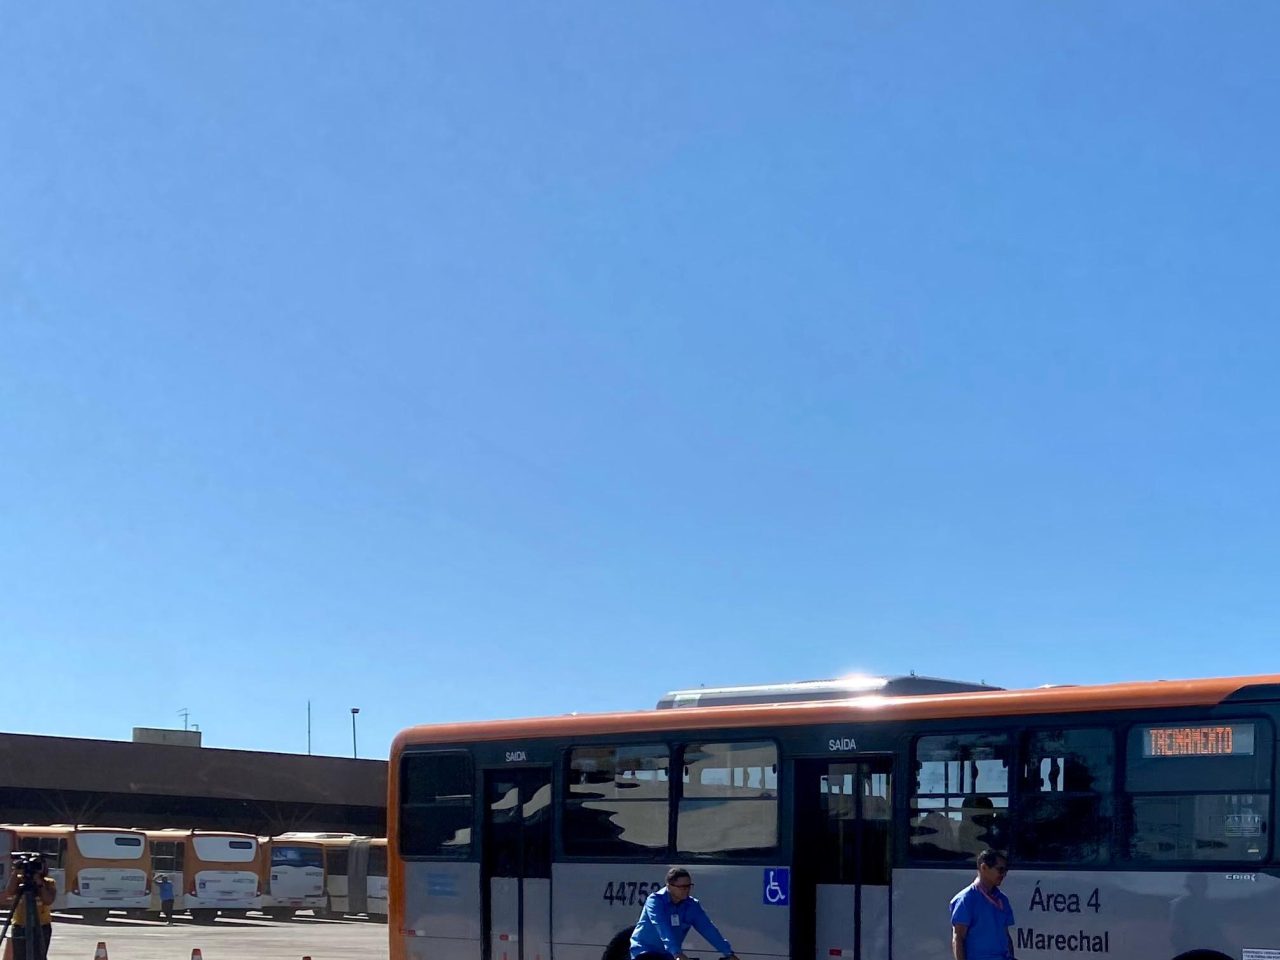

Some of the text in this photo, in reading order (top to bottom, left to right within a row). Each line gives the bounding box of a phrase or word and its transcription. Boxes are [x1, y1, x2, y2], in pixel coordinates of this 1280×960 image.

[1029, 880, 1101, 914] Área 4
[1017, 927, 1109, 953] Marechal
